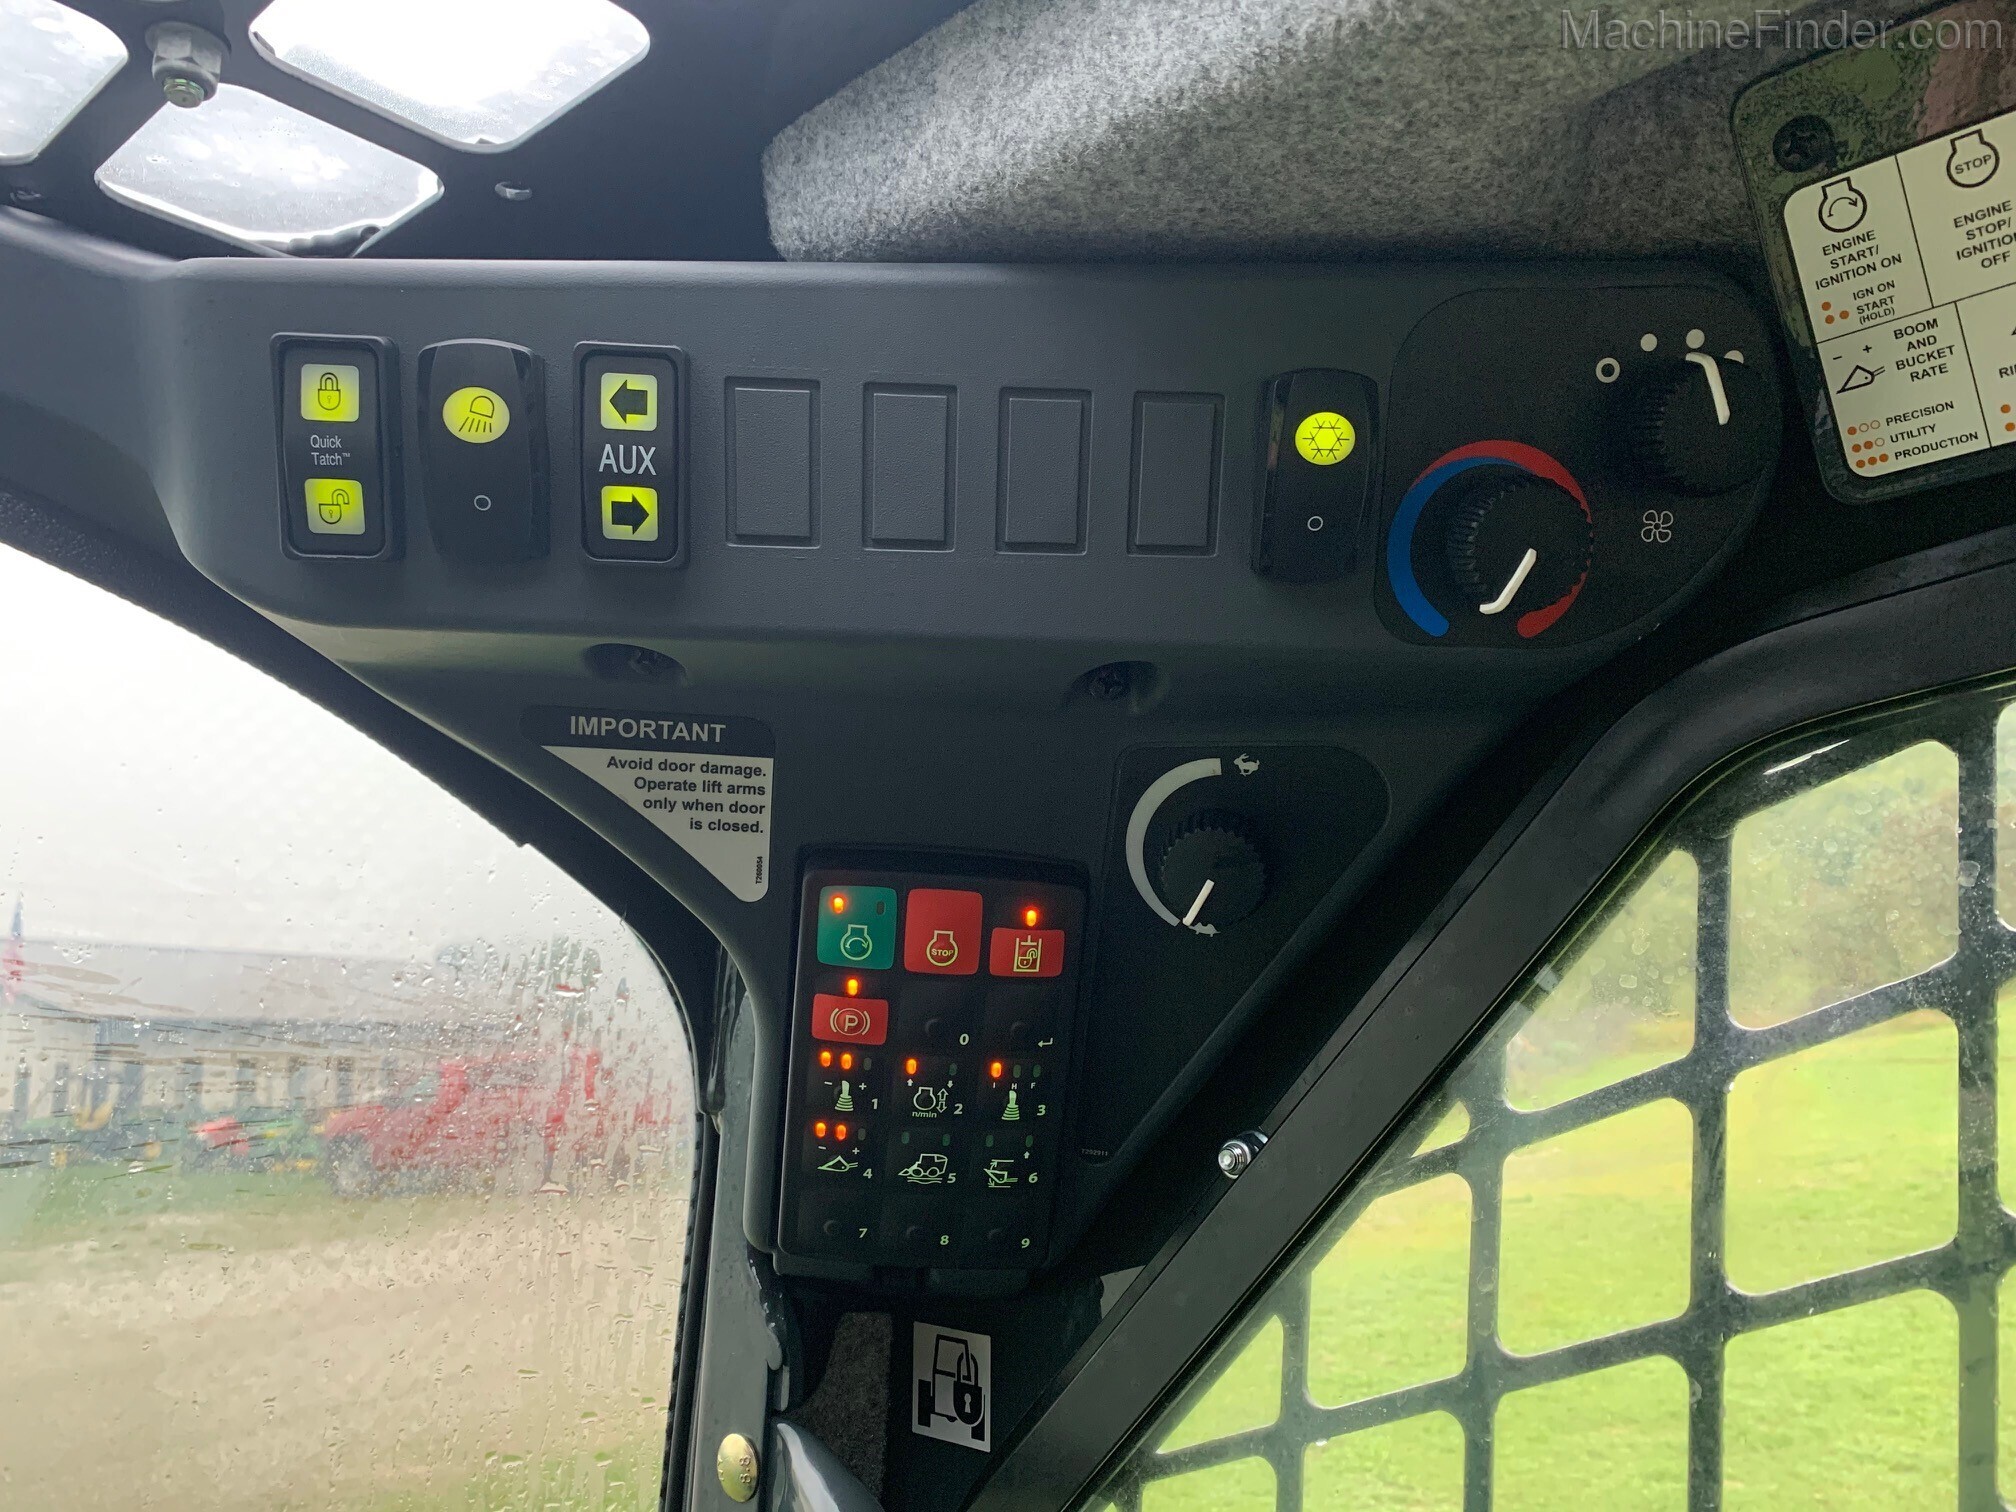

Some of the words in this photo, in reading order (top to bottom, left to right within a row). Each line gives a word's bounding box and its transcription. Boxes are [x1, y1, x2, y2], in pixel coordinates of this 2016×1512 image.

[1954, 154, 1992, 174] STOP
[1953, 200, 2013, 228] ENGINE
[1965, 216, 2012, 241] STOP/
[1822, 229, 1876, 256] ENGINE
[1956, 231, 2016, 261] IGNITIO
[1830, 244, 1879, 269] START/
[1980, 250, 2011, 269] OFF
[1815, 261, 1877, 291] IGNITION
[1881, 253, 1902, 268] ON
[1853, 286, 1875, 301] IGN
[1877, 280, 1896, 293] ON
[1856, 295, 1895, 315] START
[1859, 307, 1896, 325] (HOLD)
[1893, 317, 1939, 340] BOOM
[1907, 334, 1938, 352] AND
[1896, 345, 1956, 371] BUCKET
[1910, 363, 1949, 382] RATE
[1998, 364, 2016, 379] RI
[1885, 401, 1955, 426] PRECISION
[310, 434, 342, 448] Quick
[1890, 423, 1937, 443] UTILITY
[1894, 431, 1979, 460] PRODUCTION
[598, 443, 658, 476] AUX
[569, 715, 727, 743] IMPORTANT
[606, 755, 653, 771] Avoid
[657, 758, 696, 773] door
[700, 761, 767, 779] damage.
[634, 776, 697, 793] Operate
[702, 780, 722, 794] lift
[726, 782, 766, 796] arms
[643, 798, 678, 813] only
[682, 799, 724, 813] when
[728, 801, 766, 815] door
[689, 817, 703, 830] is
[708, 819, 764, 834] closed.
[931, 948, 954, 958] STOP
[844, 1014, 859, 1032] P
[959, 1033, 970, 1046] 0
[1030, 1082, 1036, 1090] F
[871, 1098, 878, 1110] 1
[953, 1103, 963, 1115] 2
[1036, 1104, 1047, 1116] 3
[912, 1110, 937, 1119] n/min
[863, 1168, 873, 1179] 4
[947, 1172, 957, 1184] 5
[1028, 1172, 1039, 1184] 6
[858, 1227, 868, 1238] 7
[939, 1234, 950, 1246] 8
[1021, 1237, 1031, 1249] 9
